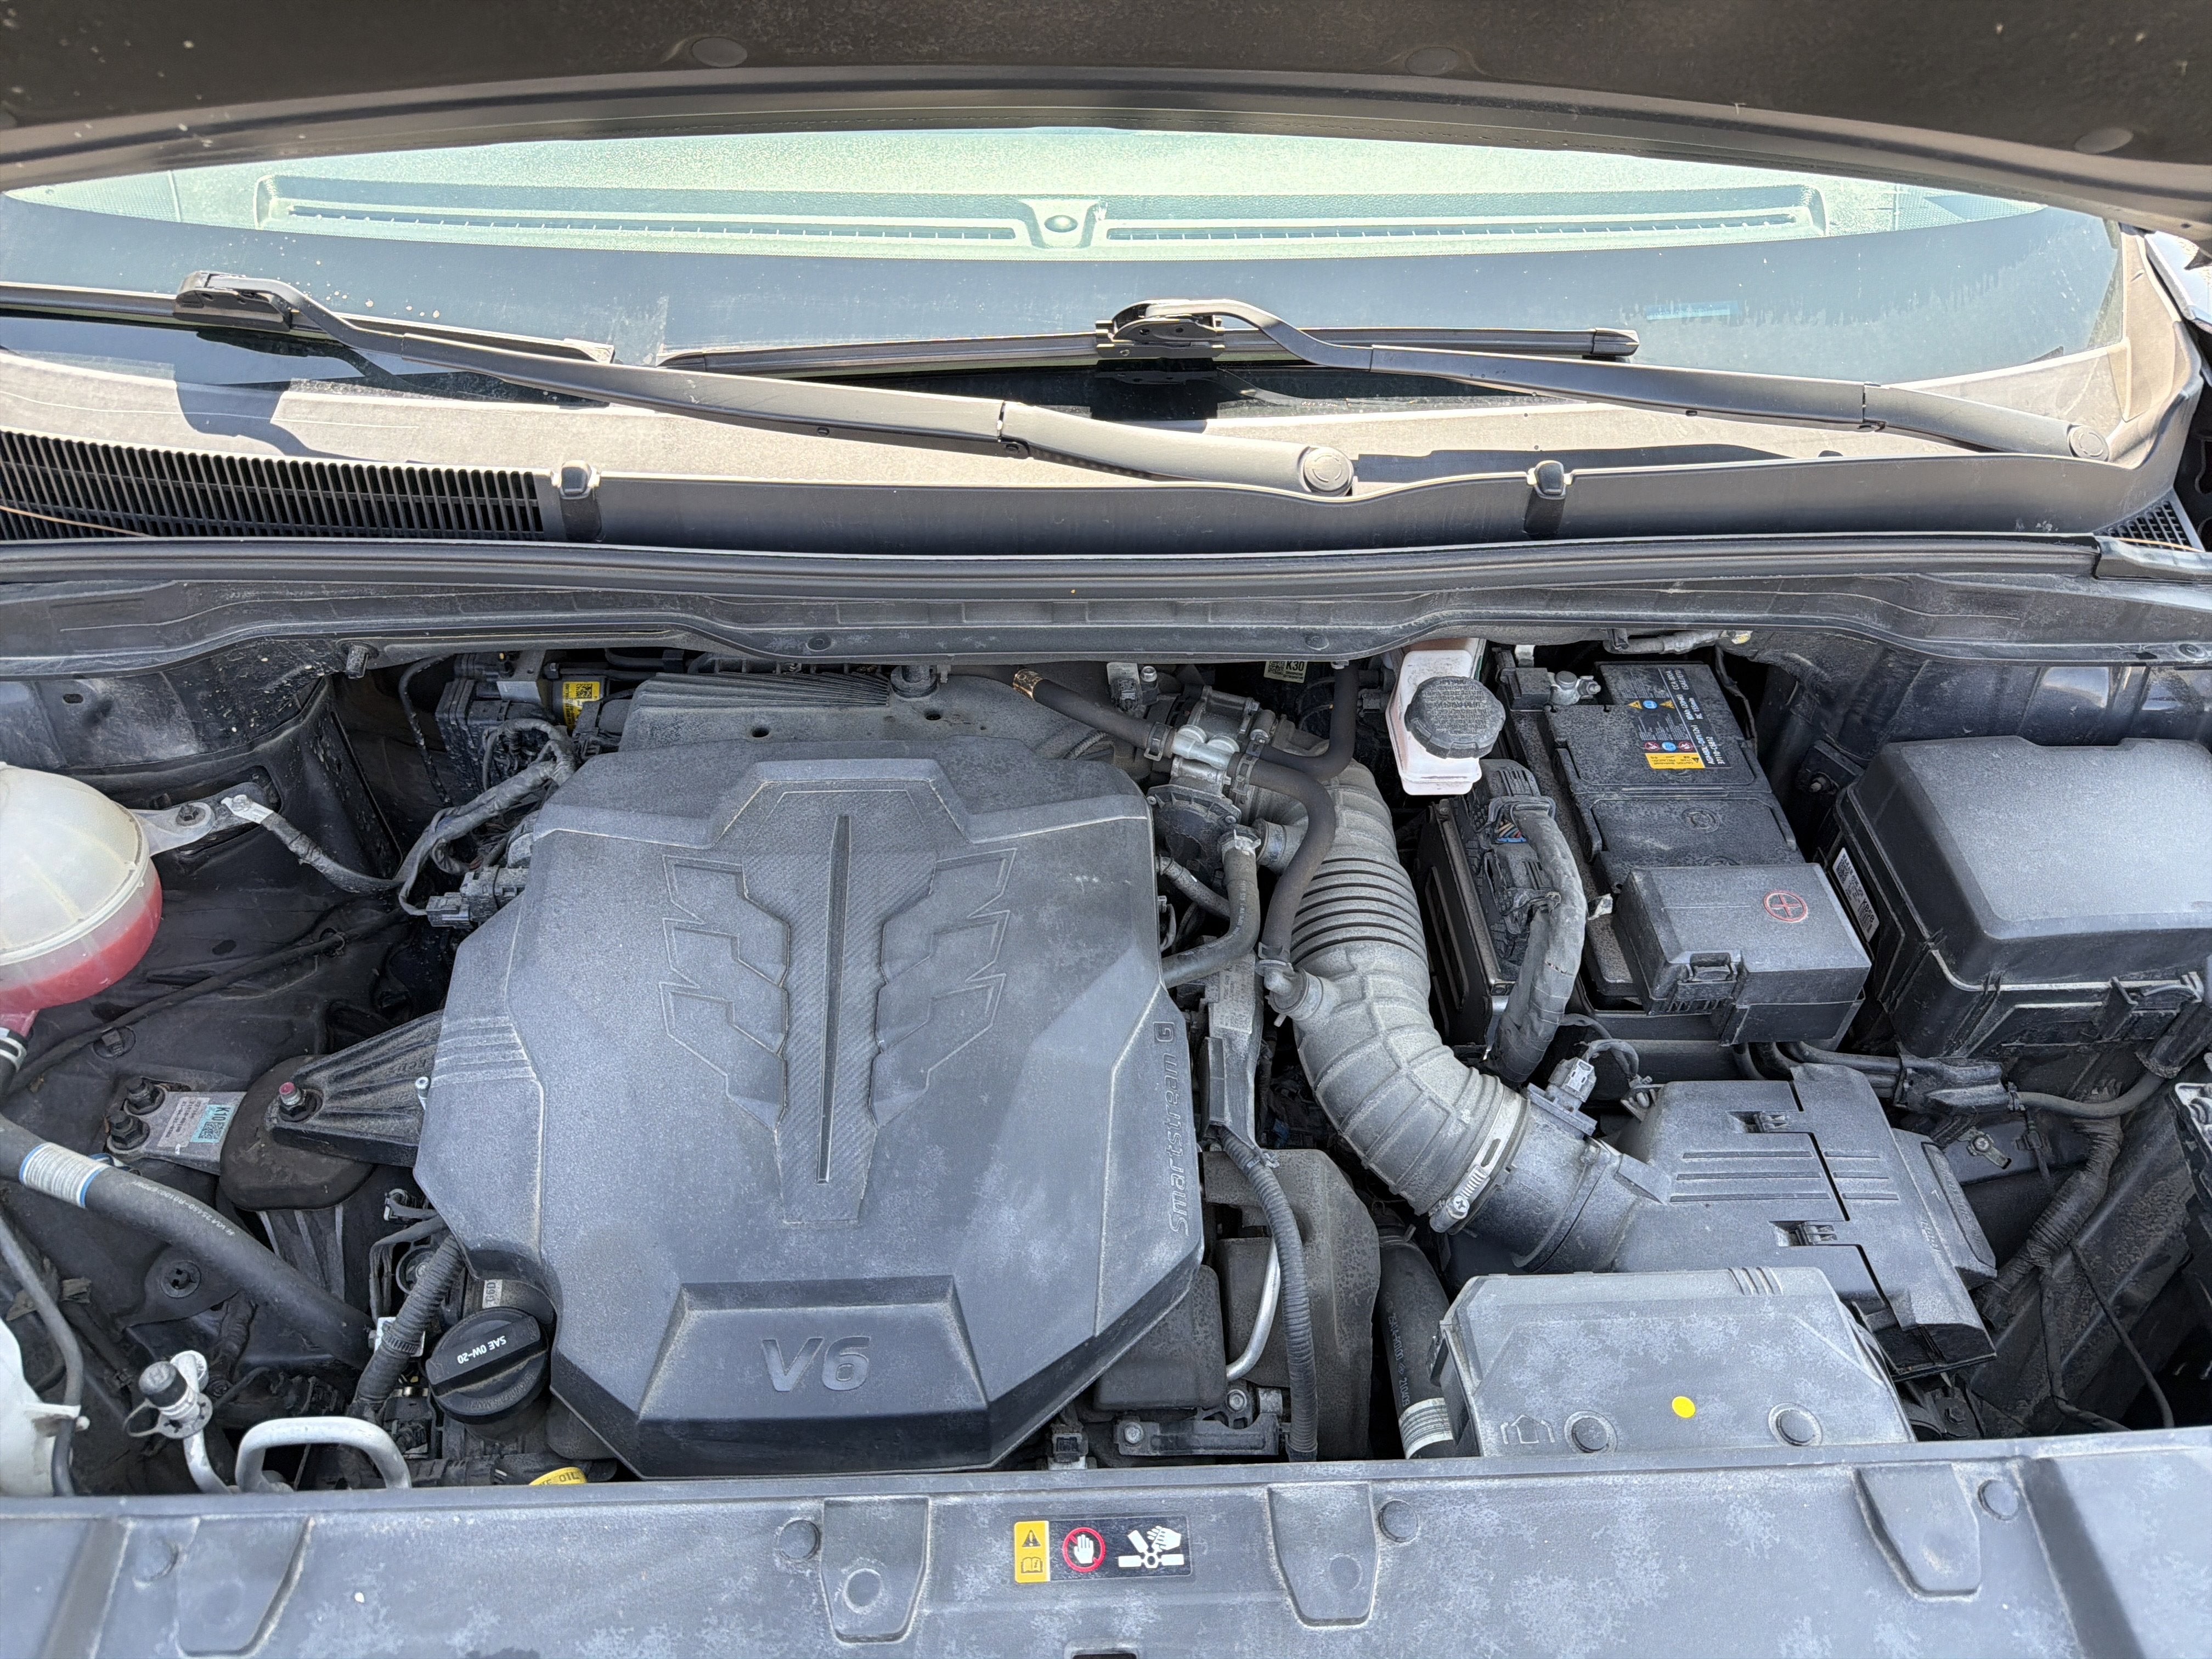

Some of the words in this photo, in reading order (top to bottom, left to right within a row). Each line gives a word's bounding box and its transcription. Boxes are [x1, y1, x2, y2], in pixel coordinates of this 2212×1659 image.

[1285, 661, 1304, 671] K30
[1671, 681, 1680, 690] CCA
[211, 1107, 231, 1121] K10
[1164, 1053, 1189, 1237] Smartstream
[488, 1336, 506, 1350] SAE
[457, 1344, 487, 1364] 0W-20
[761, 1335, 871, 1392] V6
[558, 1472, 580, 1482] OIL
